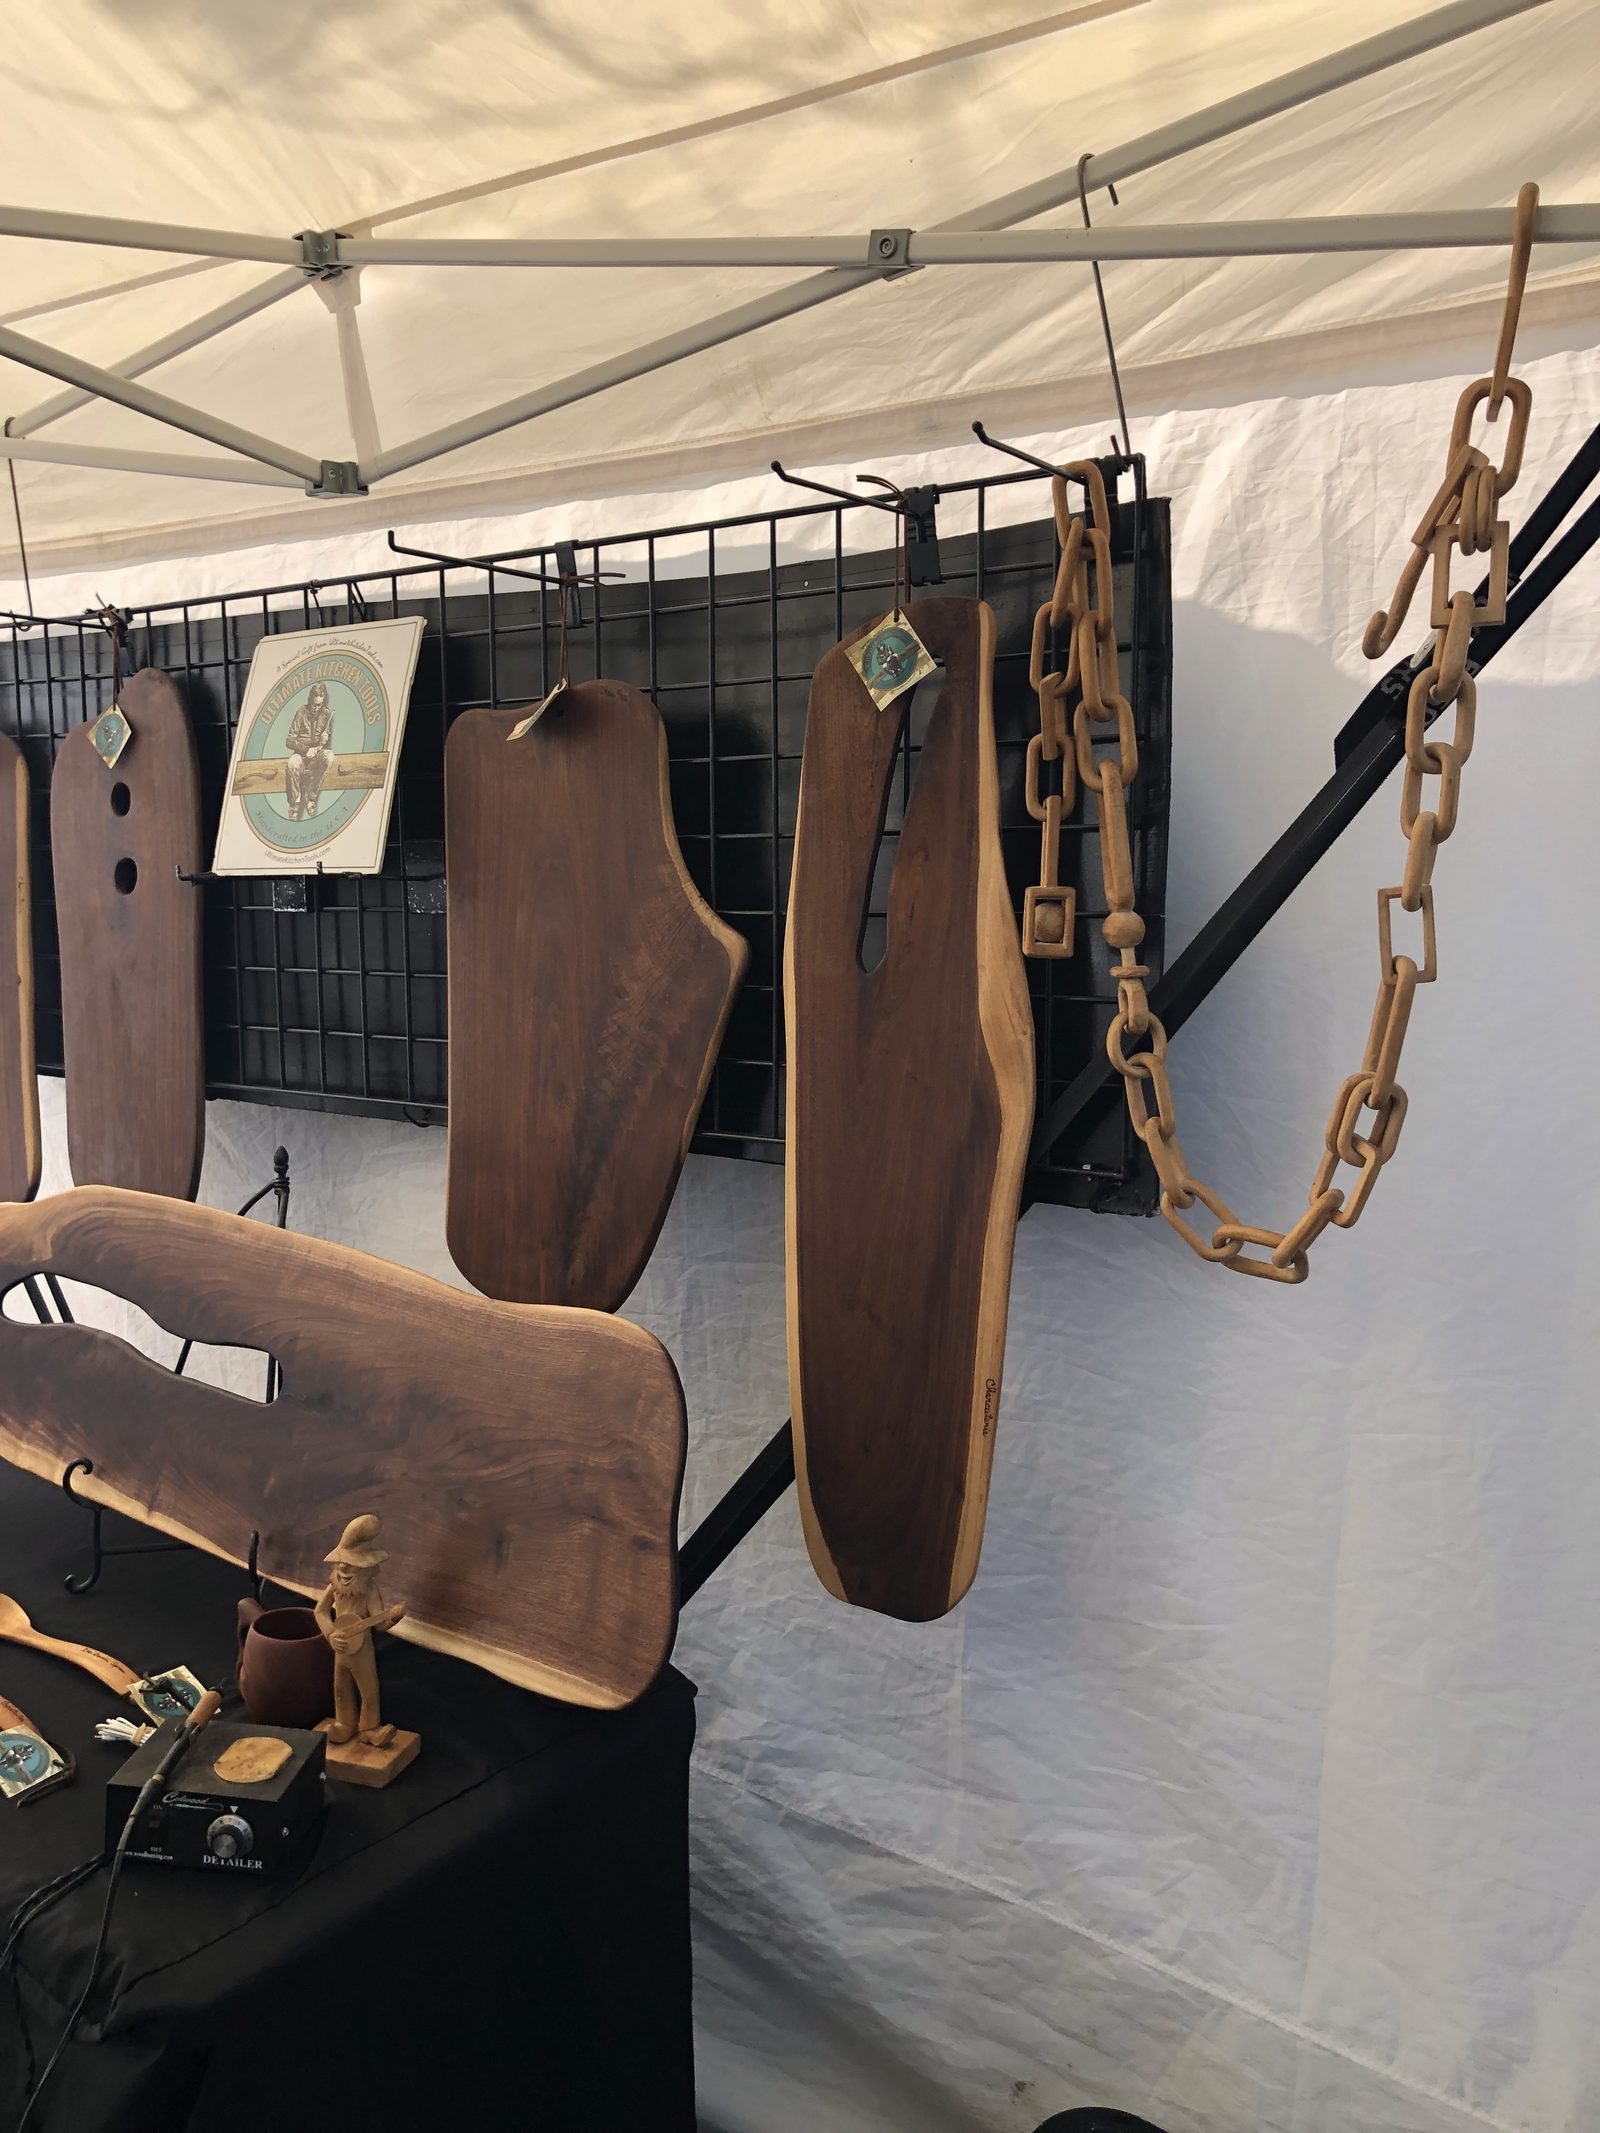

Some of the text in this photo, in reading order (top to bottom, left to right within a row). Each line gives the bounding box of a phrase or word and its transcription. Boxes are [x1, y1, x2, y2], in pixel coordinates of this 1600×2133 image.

[261, 661, 382, 726] ULTIMATE KITCHEN TOOLS
[256, 810, 298, 843] Handcrafted
[310, 829, 323, 840] the
[203, 1854, 263, 1869] DETAILER
